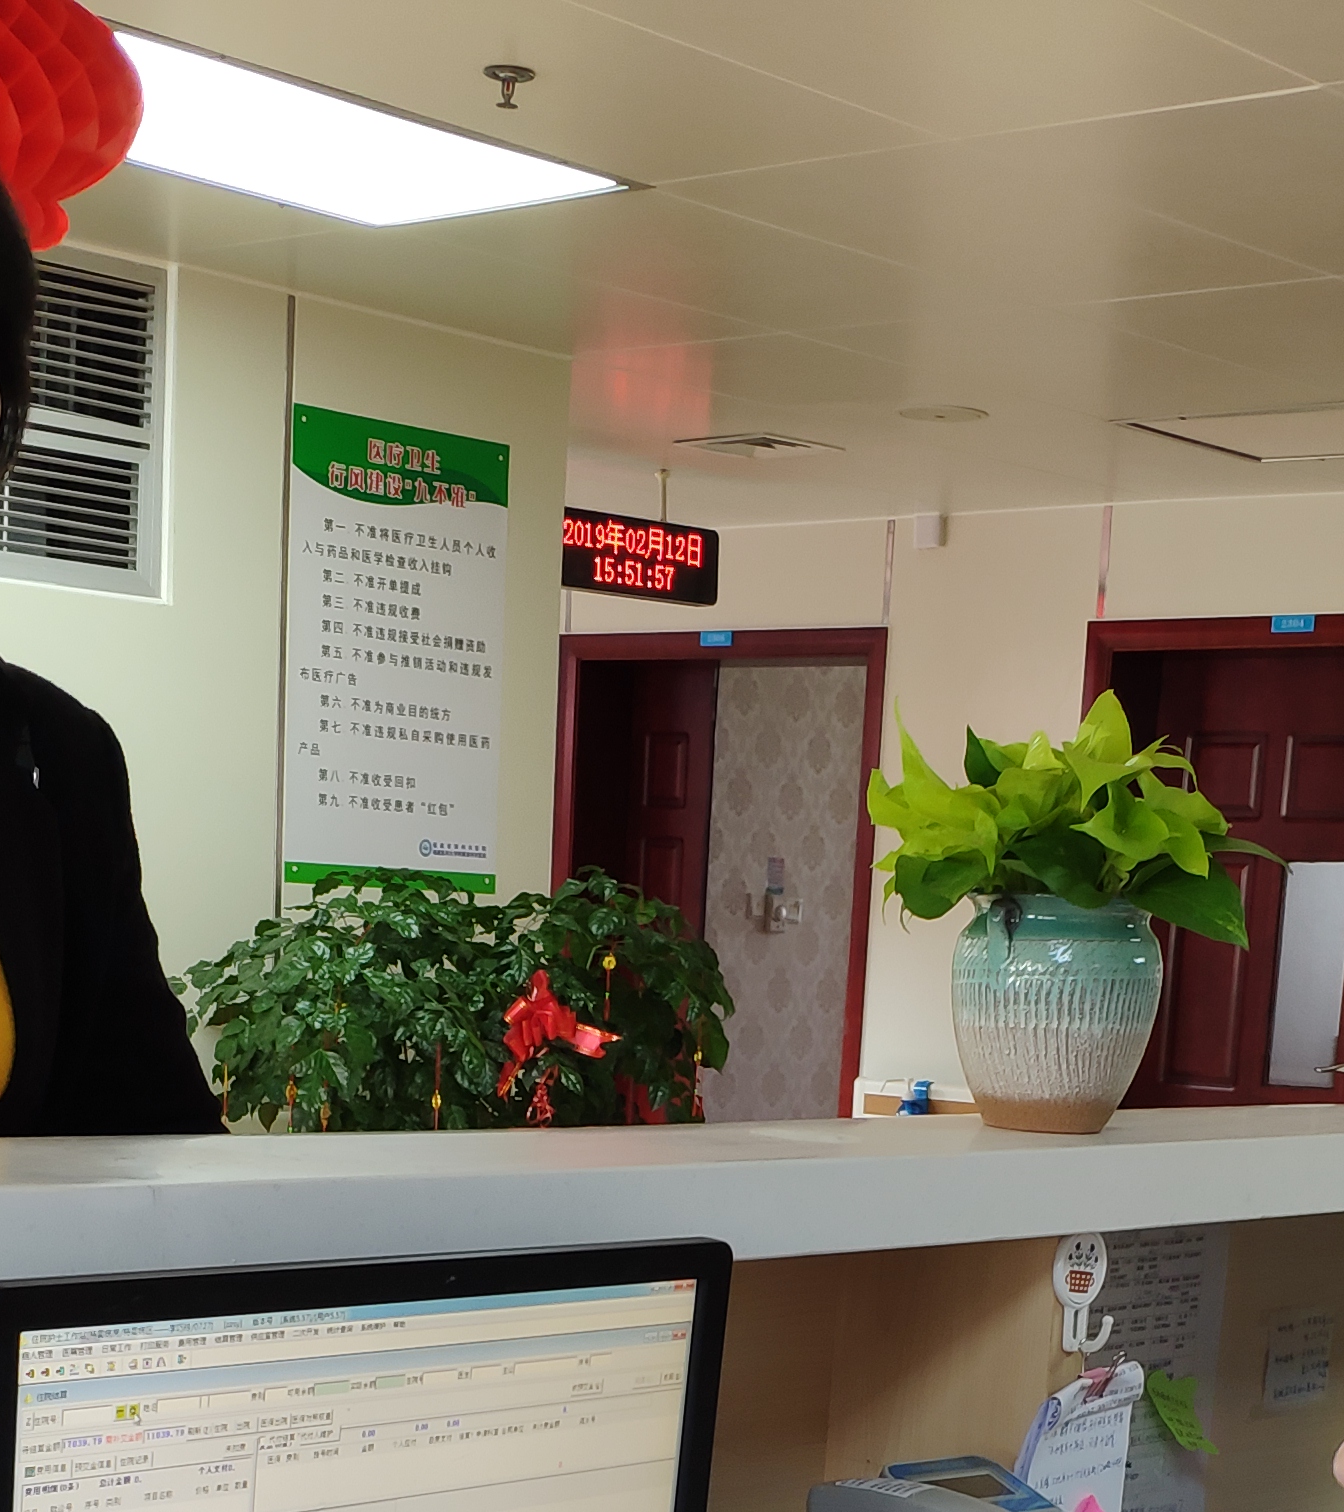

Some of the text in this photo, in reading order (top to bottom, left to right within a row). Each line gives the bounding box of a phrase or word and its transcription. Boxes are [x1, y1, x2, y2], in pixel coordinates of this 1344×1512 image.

[367, 437, 442, 475] 医疗卫生
[562, 519, 703, 568] 2019年02月12日
[593, 556, 675, 590] 15:51:57
[299, 667, 358, 687] 布医疗广告
[297, 741, 321, 756] 产品
